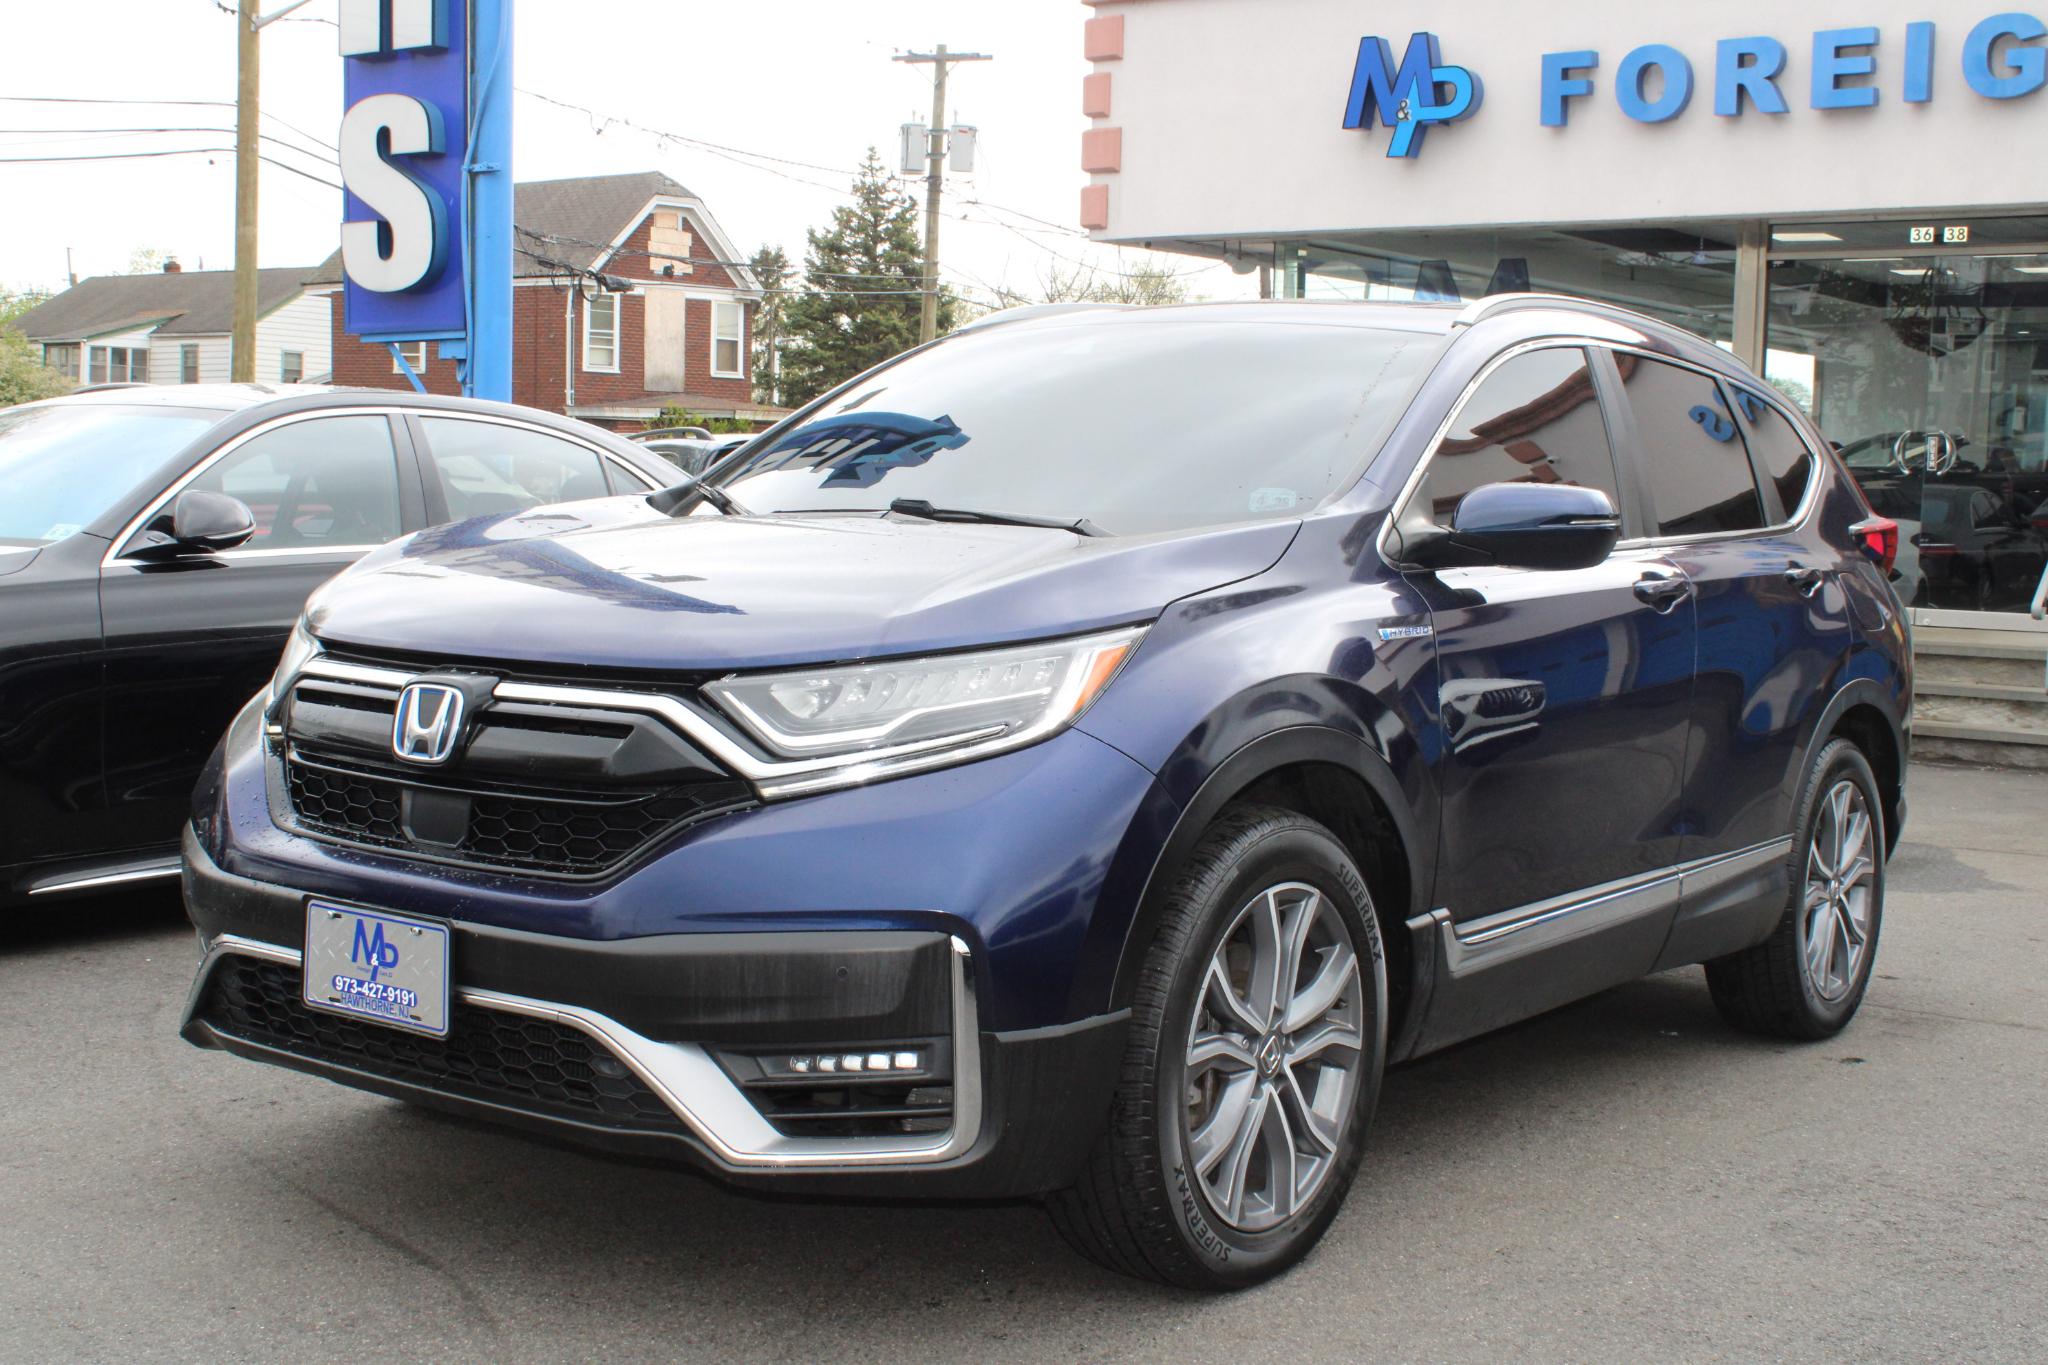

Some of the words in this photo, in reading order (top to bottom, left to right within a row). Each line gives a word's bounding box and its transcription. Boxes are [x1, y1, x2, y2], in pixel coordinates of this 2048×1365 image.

[1541, 13, 2048, 126] FOREIG
[1912, 228, 1932, 241] 36
[1946, 227, 1966, 241] 38
[1336, 863, 1383, 963] SUPERMAX
[334, 975, 416, 1007] 973-427-9191
[399, 1004, 410, 1019] NJ
[1173, 1163, 1232, 1262] SUPERMAX
